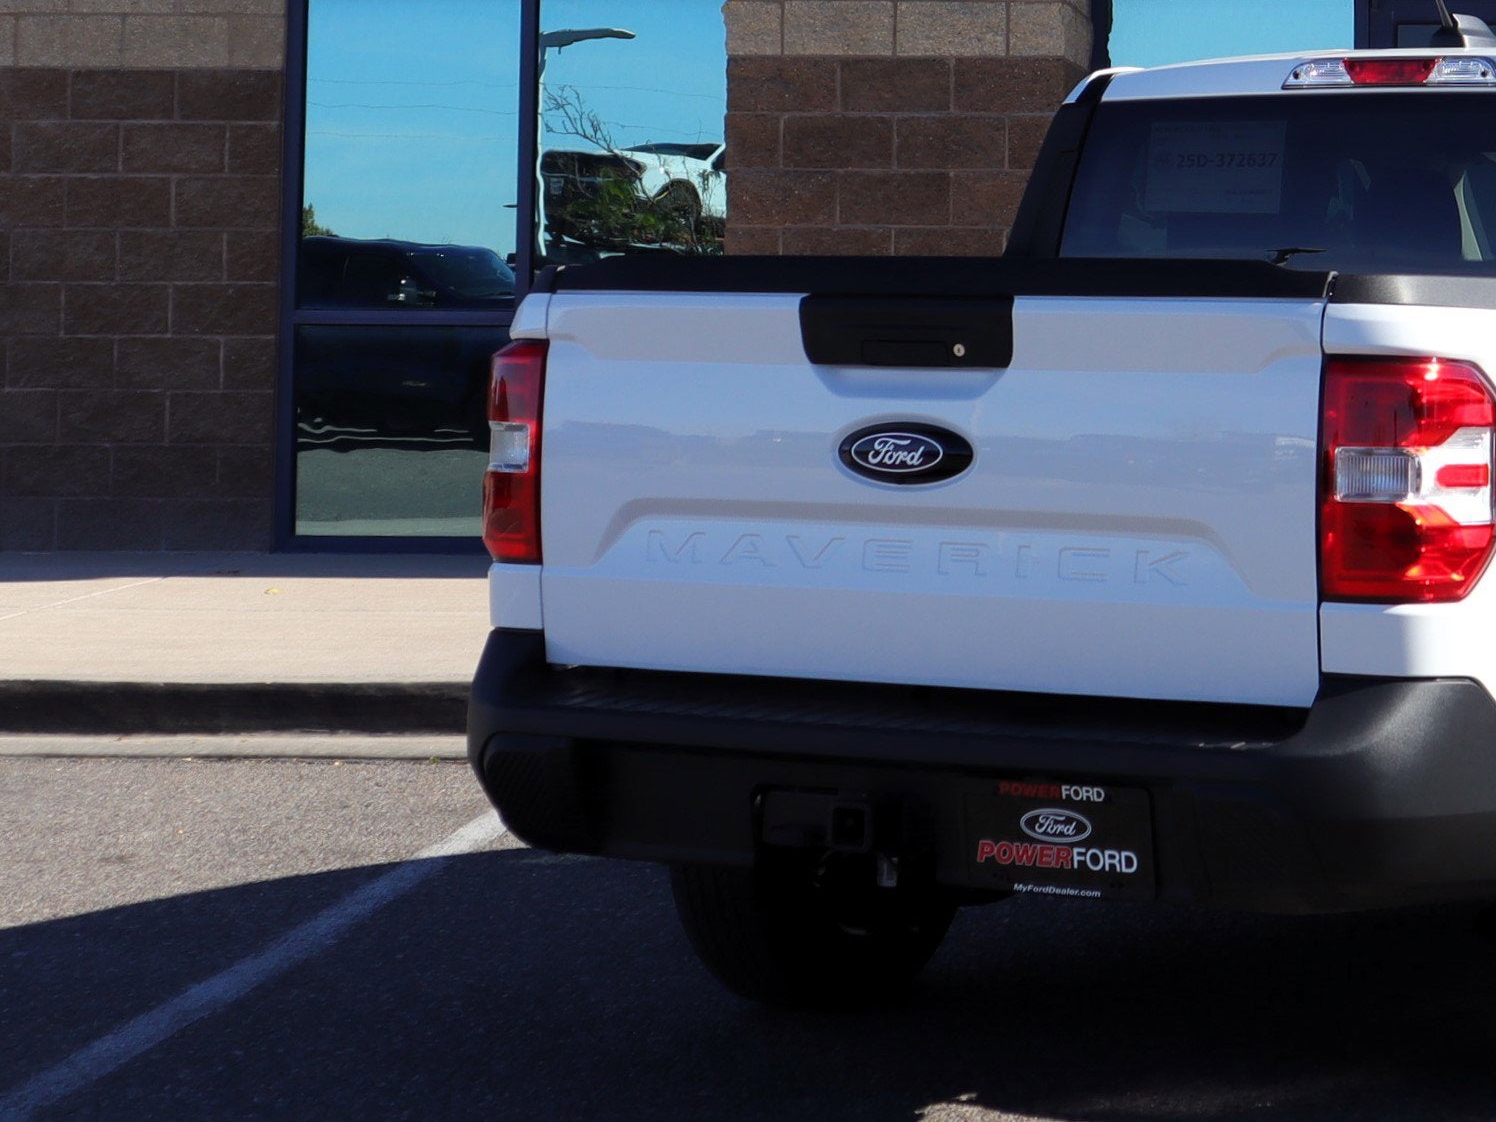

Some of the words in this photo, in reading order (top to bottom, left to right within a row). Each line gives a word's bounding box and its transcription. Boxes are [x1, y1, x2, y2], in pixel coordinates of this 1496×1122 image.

[867, 436, 924, 468] Ford
[645, 529, 1192, 586] MAVERICK
[1034, 814, 1077, 836] Ford
[1013, 882, 1102, 898] MyFordDealer.com
